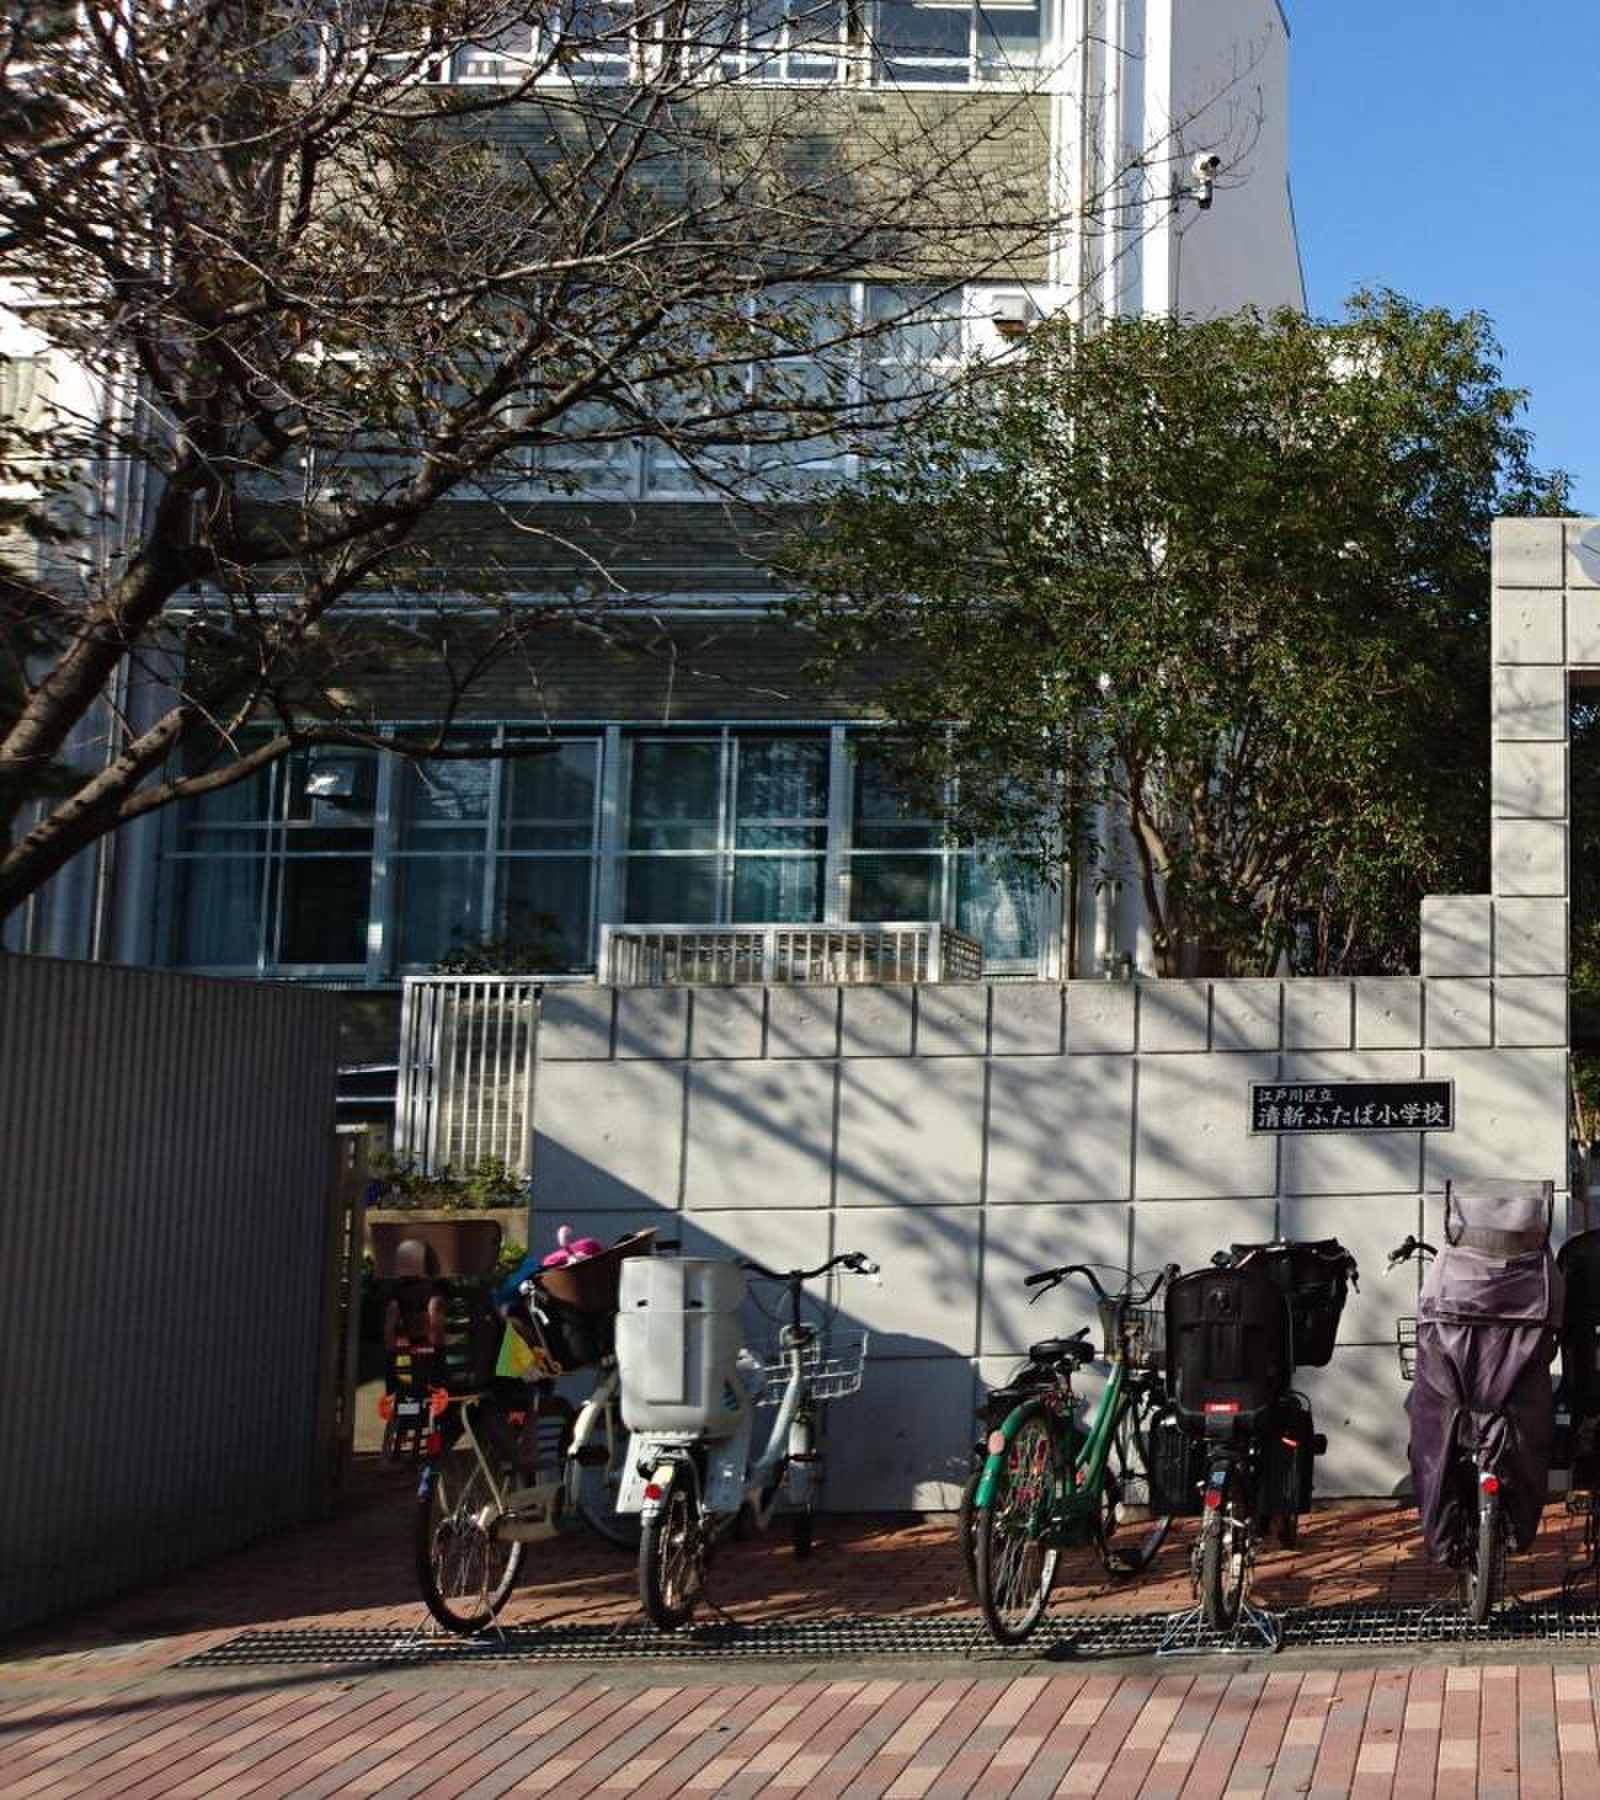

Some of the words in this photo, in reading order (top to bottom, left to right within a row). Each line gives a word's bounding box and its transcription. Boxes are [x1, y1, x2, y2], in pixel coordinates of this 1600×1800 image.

[1258, 1087, 1336, 1103] 江戸川区立
[1258, 1103, 1445, 1127] 清新ふたば小学校
